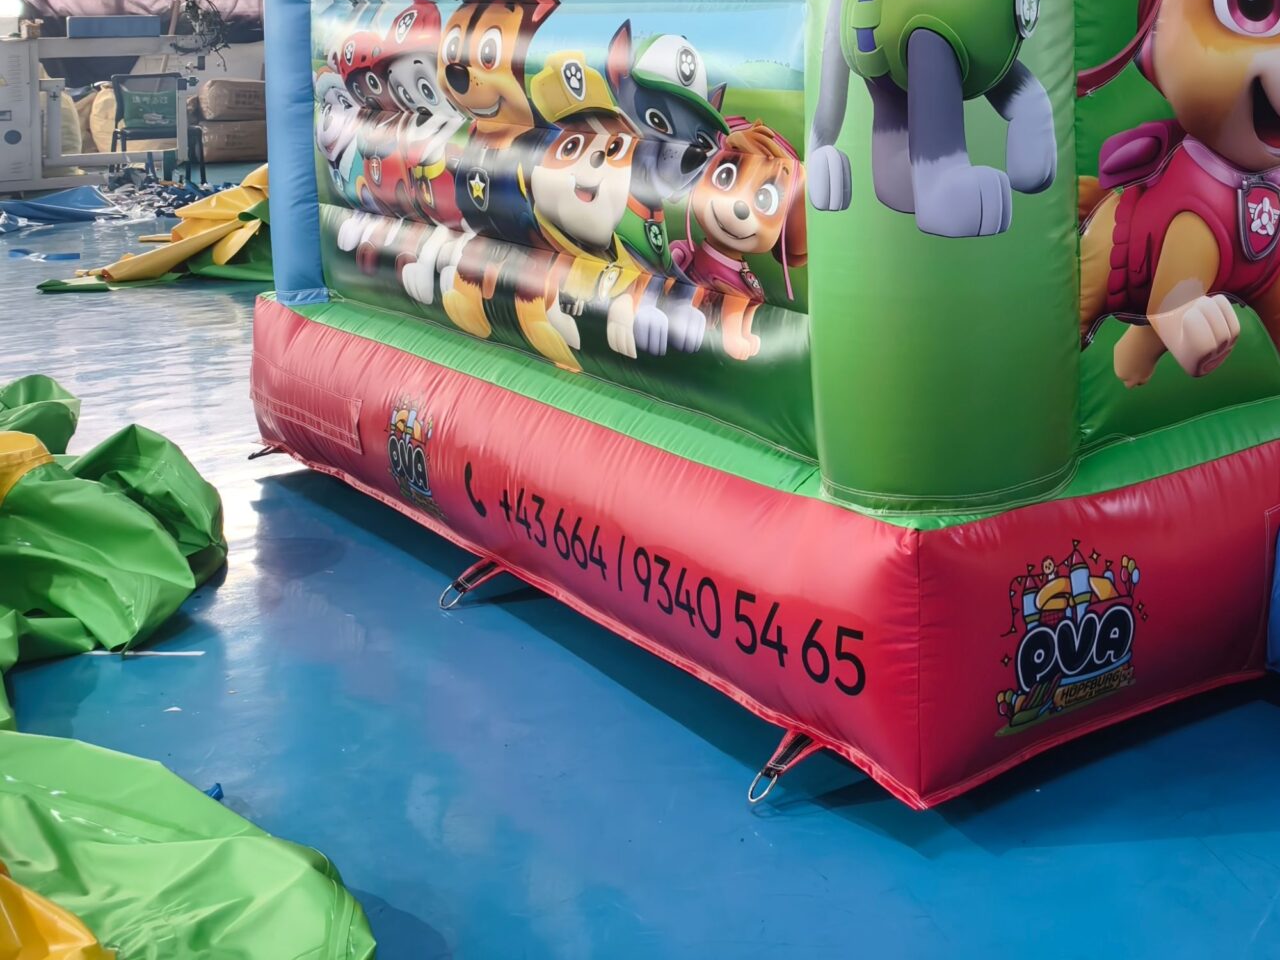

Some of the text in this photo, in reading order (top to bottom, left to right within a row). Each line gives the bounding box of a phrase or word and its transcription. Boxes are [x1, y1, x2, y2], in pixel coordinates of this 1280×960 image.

[388, 435, 429, 490] PVA
[499, 487, 547, 548] +43
[554, 508, 608, 580] 664
[633, 546, 722, 639] 9340
[1016, 604, 1134, 692] PVA
